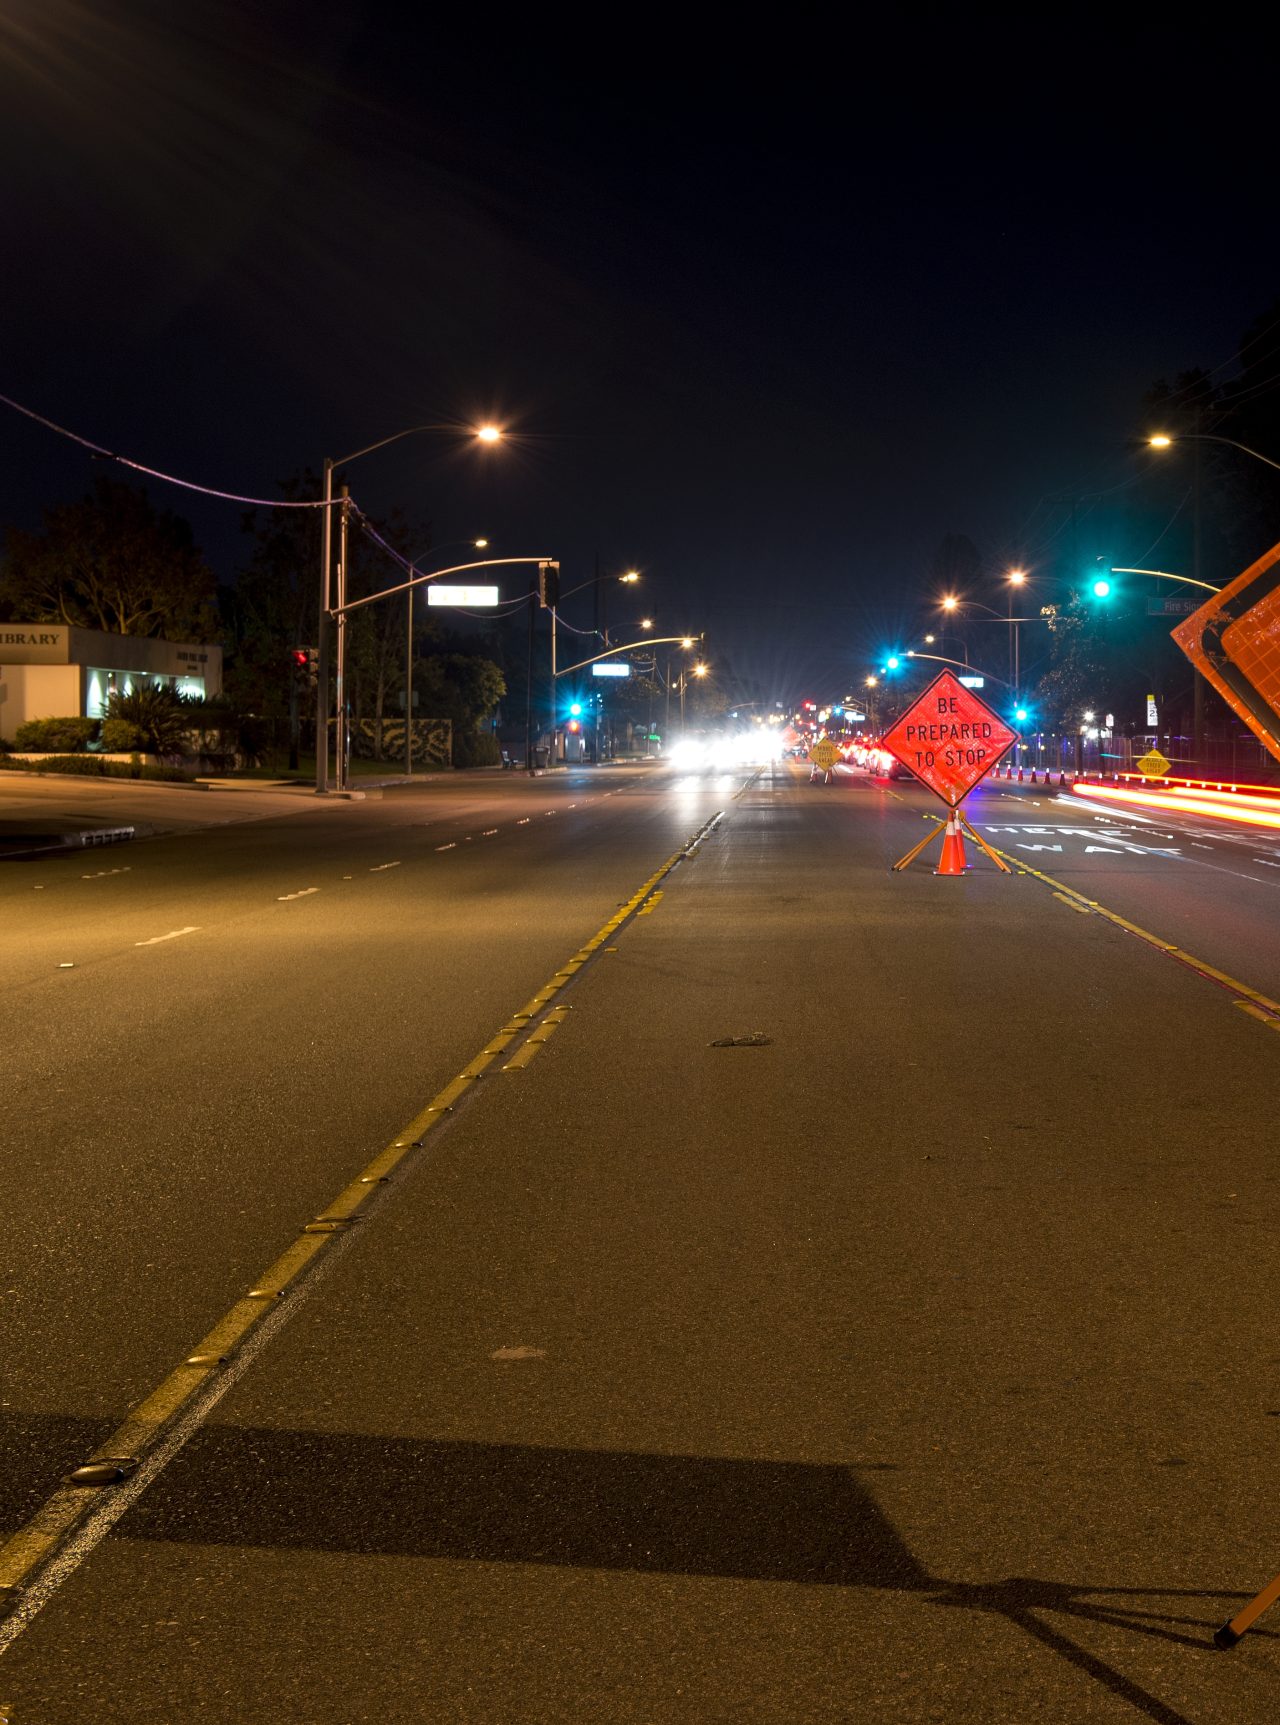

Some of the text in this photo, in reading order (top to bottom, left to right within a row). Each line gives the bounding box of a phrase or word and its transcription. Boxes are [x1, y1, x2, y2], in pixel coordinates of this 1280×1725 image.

[1164, 600, 1181, 612] Fire
[937, 697, 959, 714] BE
[906, 722, 992, 742] PREPARED
[914, 749, 986, 768] TO STOP
